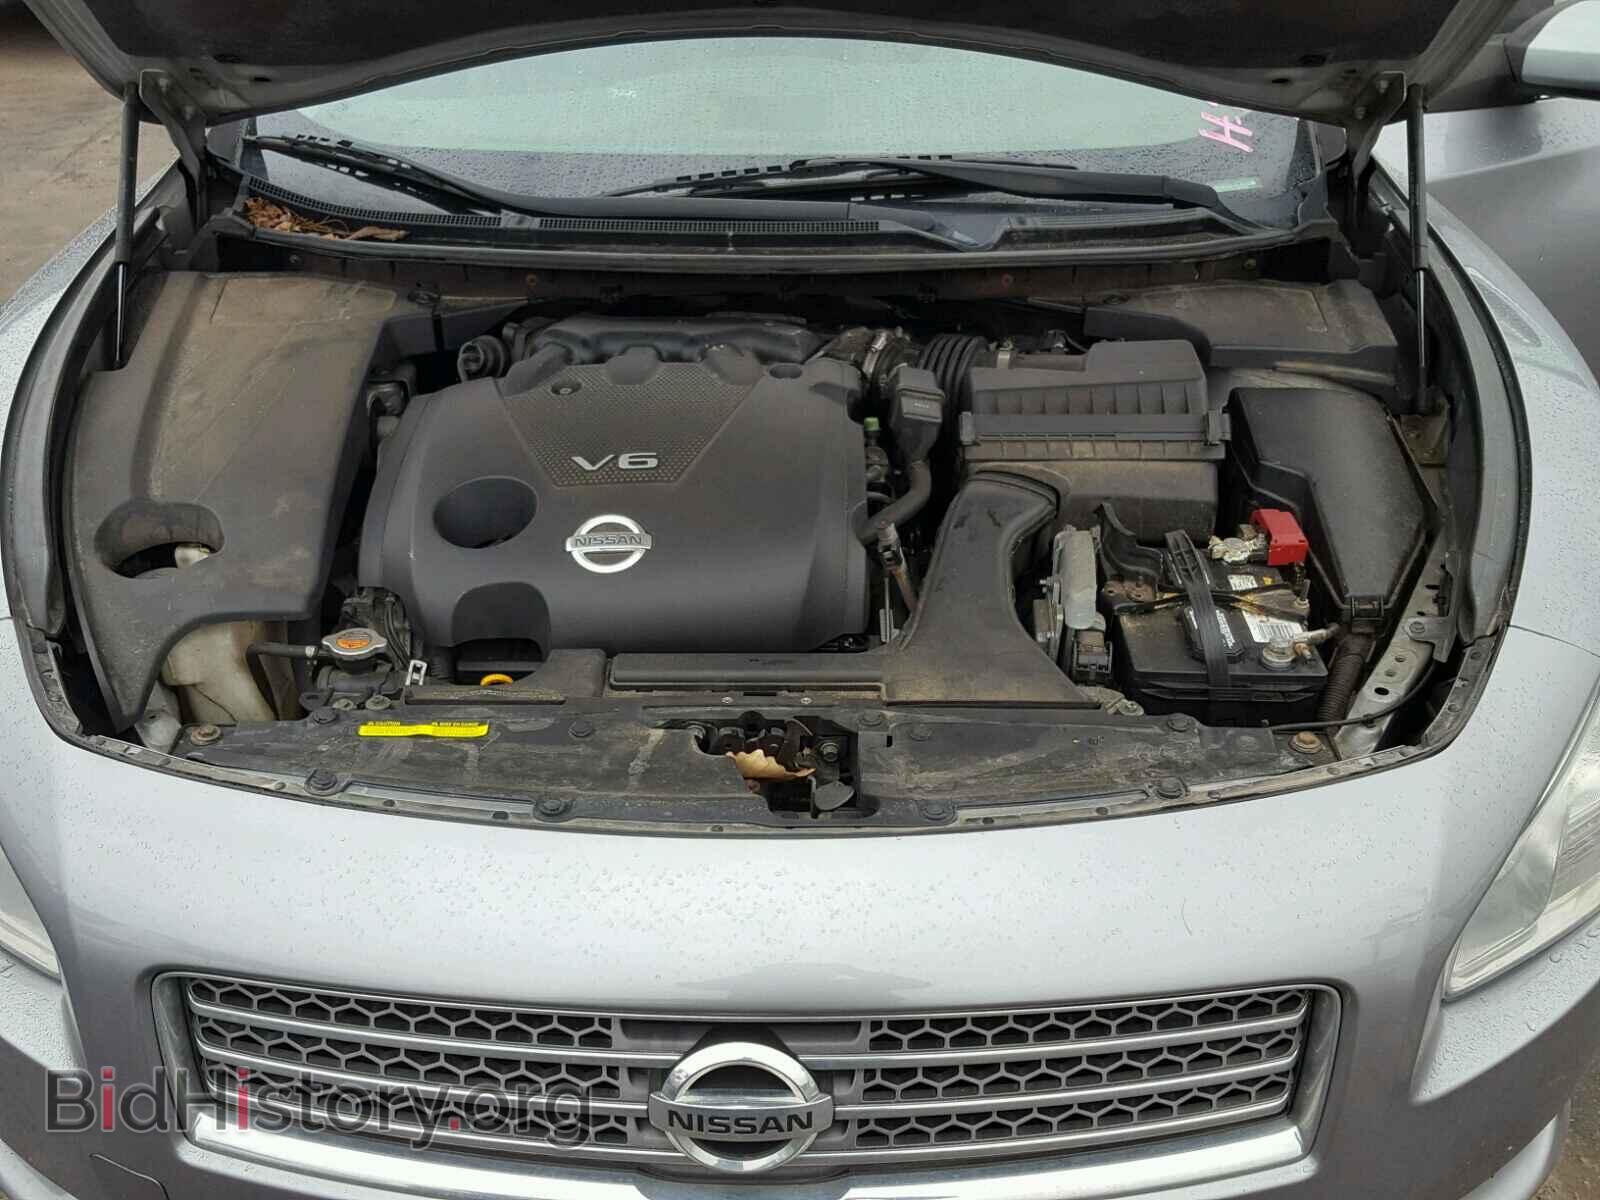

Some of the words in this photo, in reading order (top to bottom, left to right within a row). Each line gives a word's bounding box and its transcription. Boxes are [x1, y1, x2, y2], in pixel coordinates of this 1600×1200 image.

[571, 452, 658, 471] V6
[575, 535, 643, 547] NISSAN
[668, 1109, 813, 1134] NISSAN
